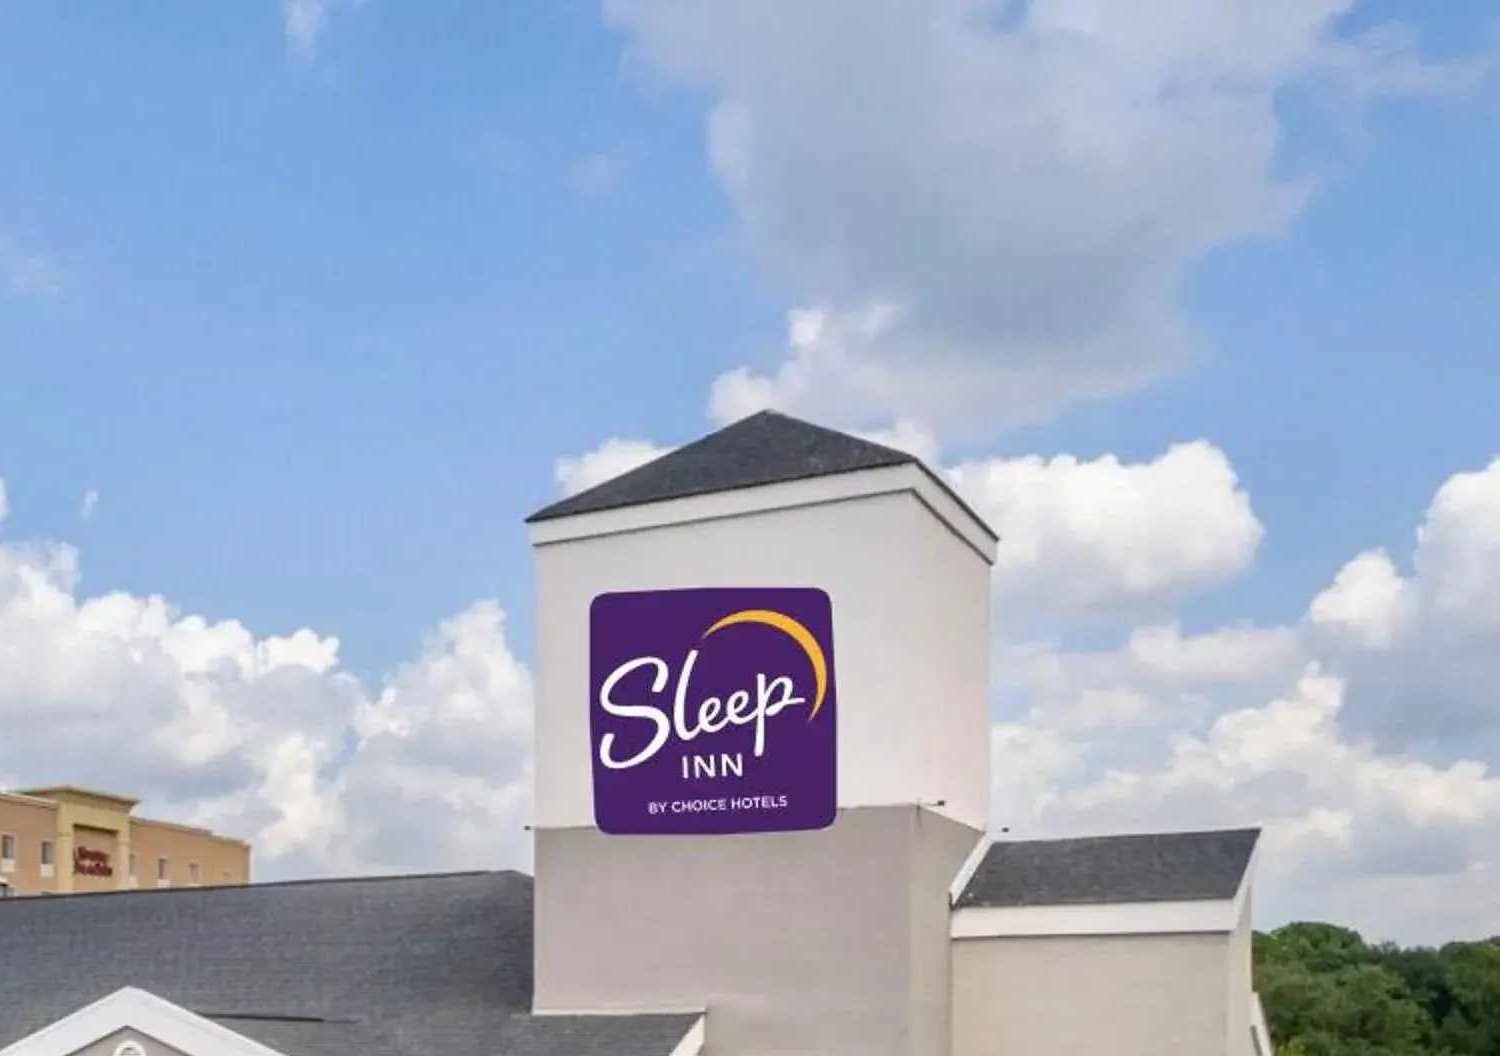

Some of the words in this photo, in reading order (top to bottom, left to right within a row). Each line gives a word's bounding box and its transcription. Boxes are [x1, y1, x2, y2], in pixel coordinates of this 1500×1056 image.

[600, 650, 805, 769] Sleep
[682, 753, 743, 778] INN
[648, 802, 667, 814] BY
[671, 799, 727, 812] CHOICE
[731, 796, 787, 809] HOTELS
